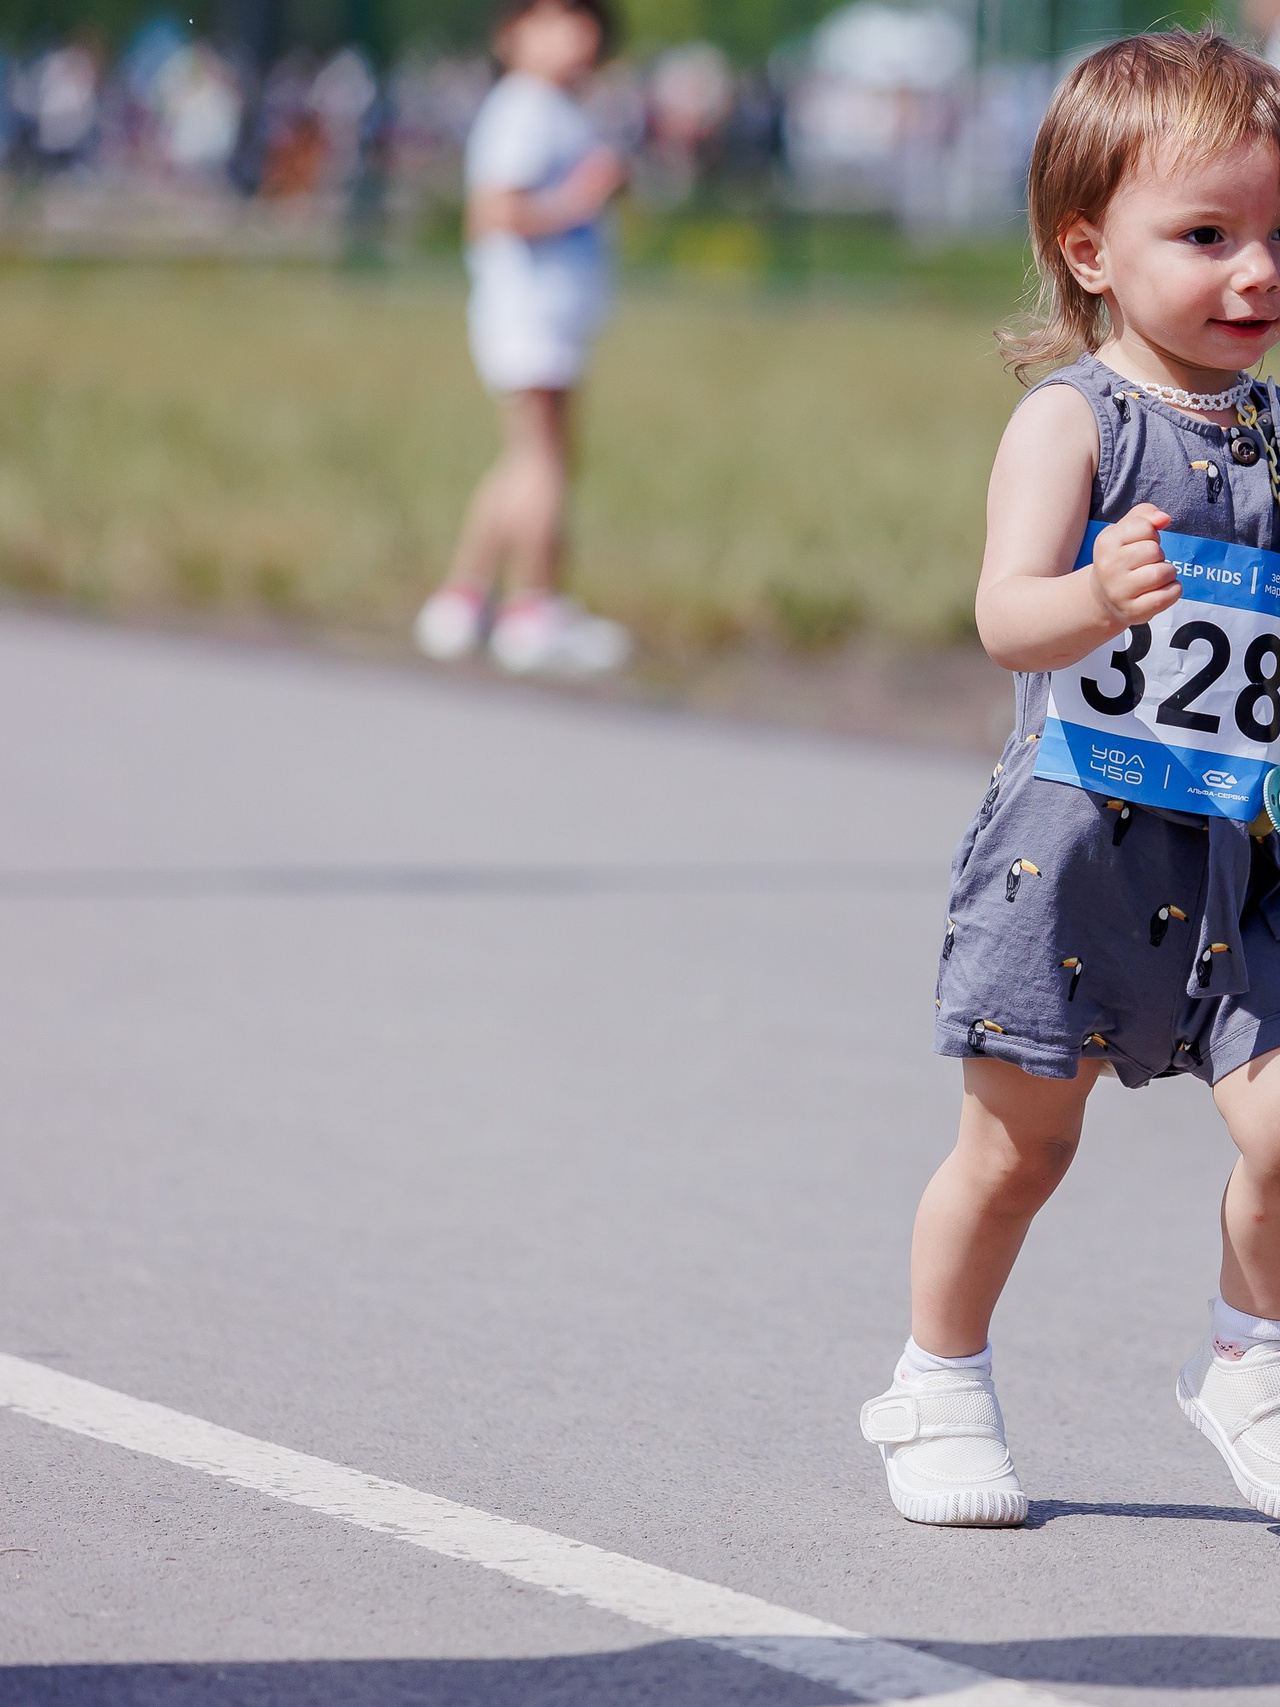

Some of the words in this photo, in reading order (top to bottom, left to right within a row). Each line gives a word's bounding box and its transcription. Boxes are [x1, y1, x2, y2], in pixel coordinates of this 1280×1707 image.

[1164, 559, 1204, 578] БЕР
[1205, 567, 1242, 586] KIDS
[1091, 744, 1146, 769] УФА
[1090, 760, 1143, 786] 450
[1187, 786, 1250, 803] АЛЬФА-СЕРВИС
